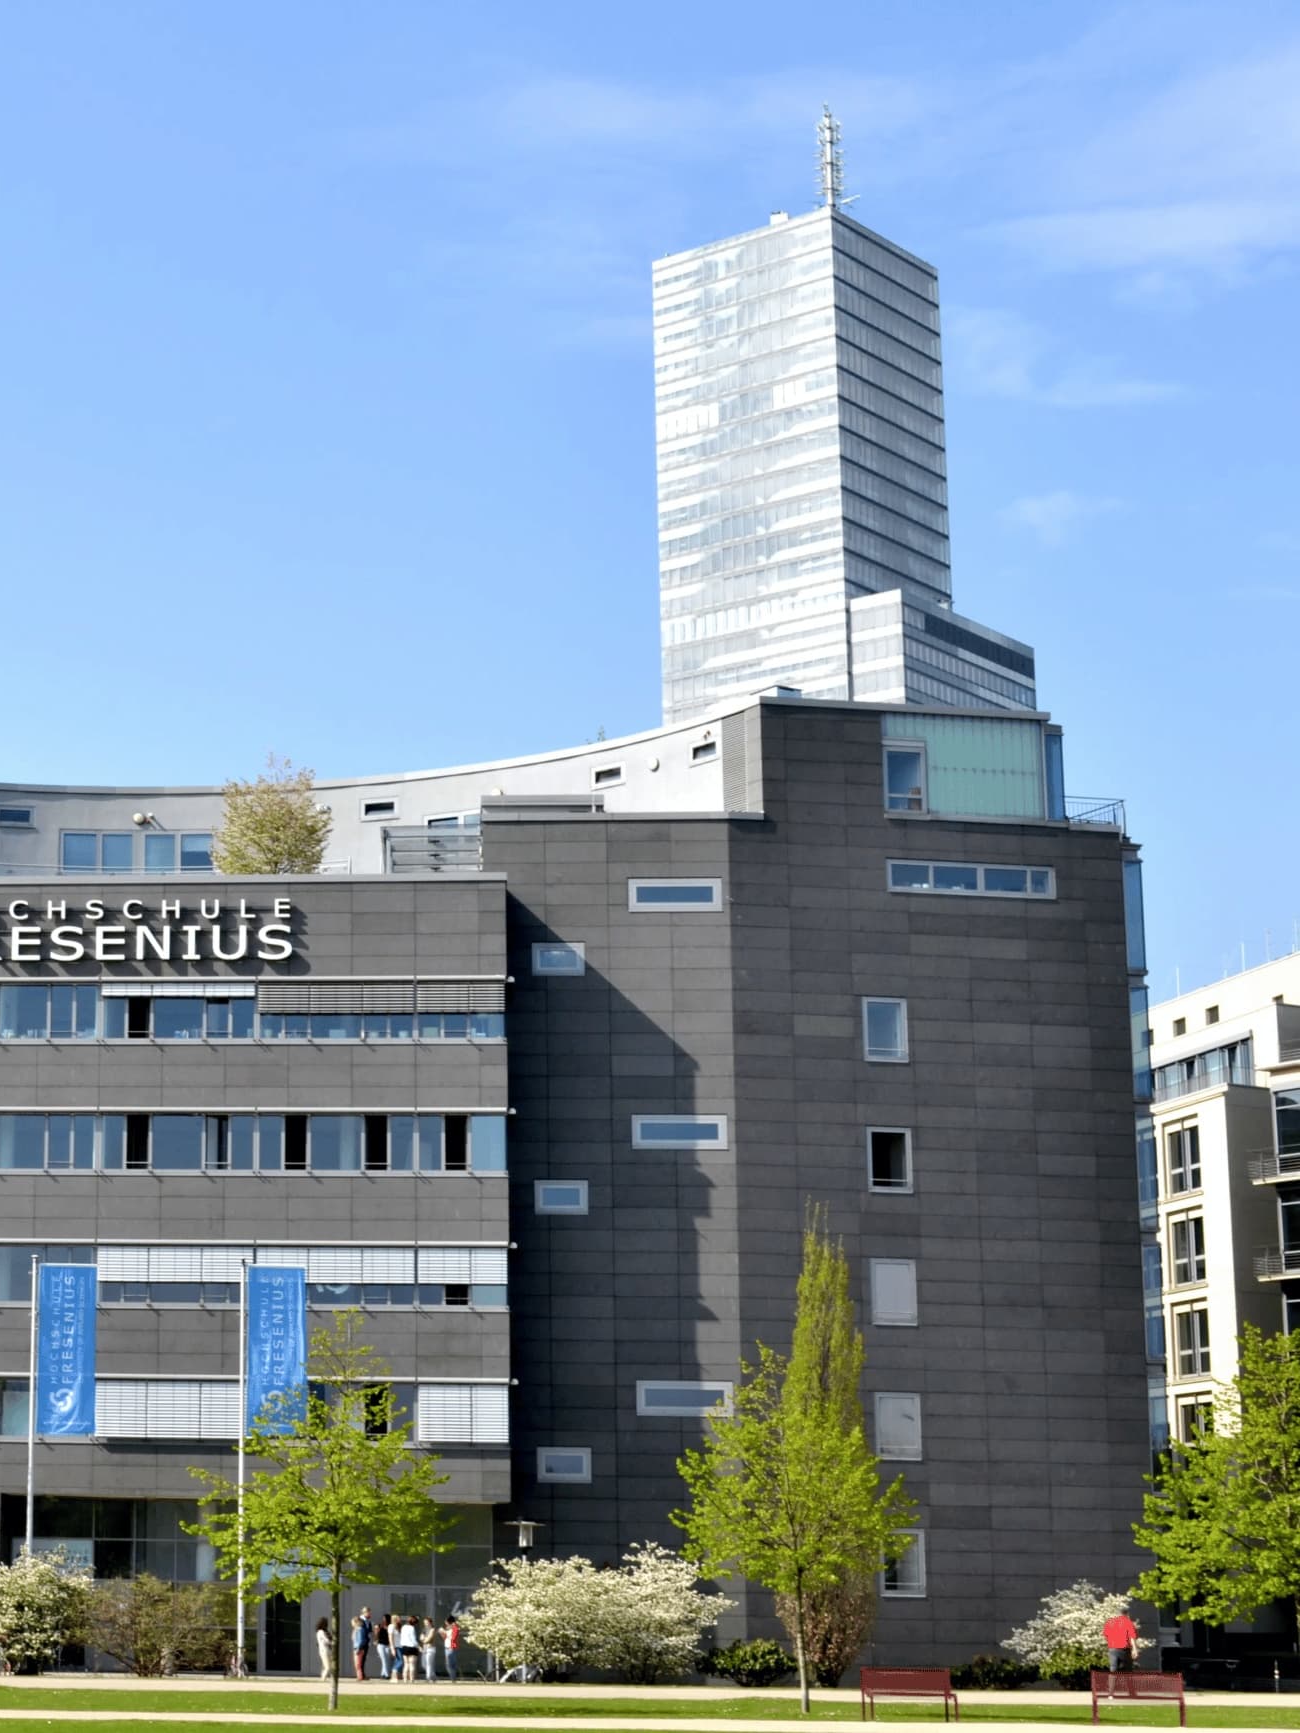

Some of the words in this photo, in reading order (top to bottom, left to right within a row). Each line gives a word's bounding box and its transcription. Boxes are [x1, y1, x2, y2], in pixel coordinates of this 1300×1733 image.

[50, 1275, 61, 1384] HOCHSCHULE
[61, 1275, 75, 1384] FRESENIUS
[260, 1274, 270, 1385] HOCHSCHULE
[272, 1277, 284, 1386] FRESENIUS
